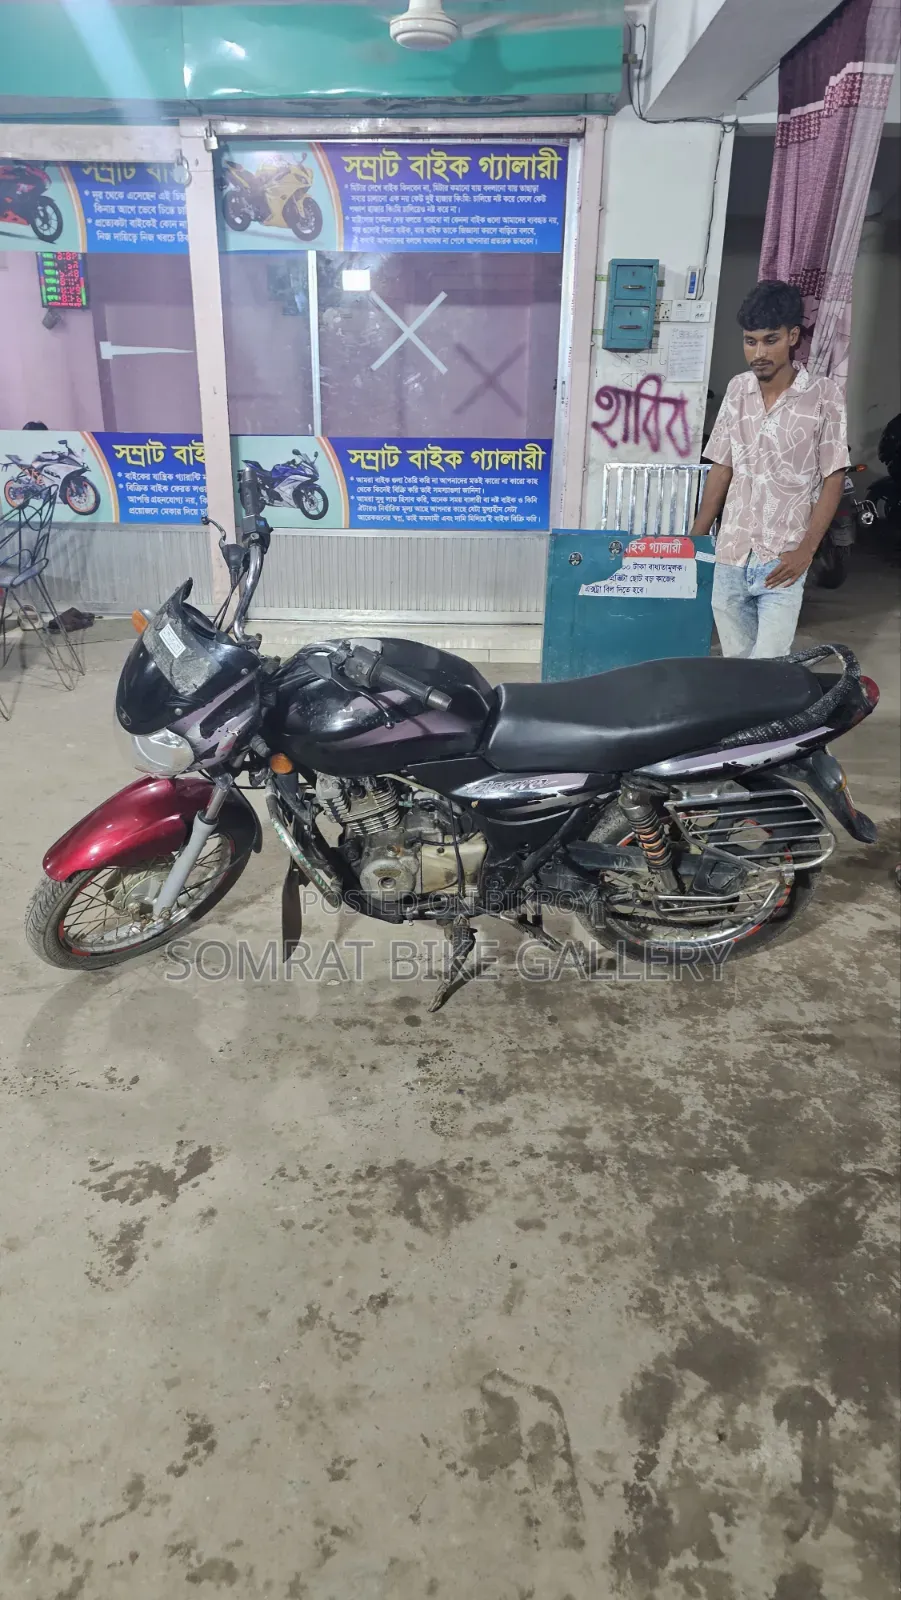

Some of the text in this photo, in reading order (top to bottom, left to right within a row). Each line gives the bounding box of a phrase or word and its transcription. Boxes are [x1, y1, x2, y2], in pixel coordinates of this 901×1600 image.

[341, 147, 562, 183] সম্রাট বাইক গ্যালারী
[112, 438, 205, 467] সম্রাট বাই
[346, 443, 546, 472] সম্রাট বাইক গ্যালারী
[649, 539, 682, 554] গ্যালারী
[632, 562, 647, 571] টাকা
[629, 575, 643, 583] ছোট
[644, 575, 654, 583] বড়
[655, 575, 675, 583] কাজের
